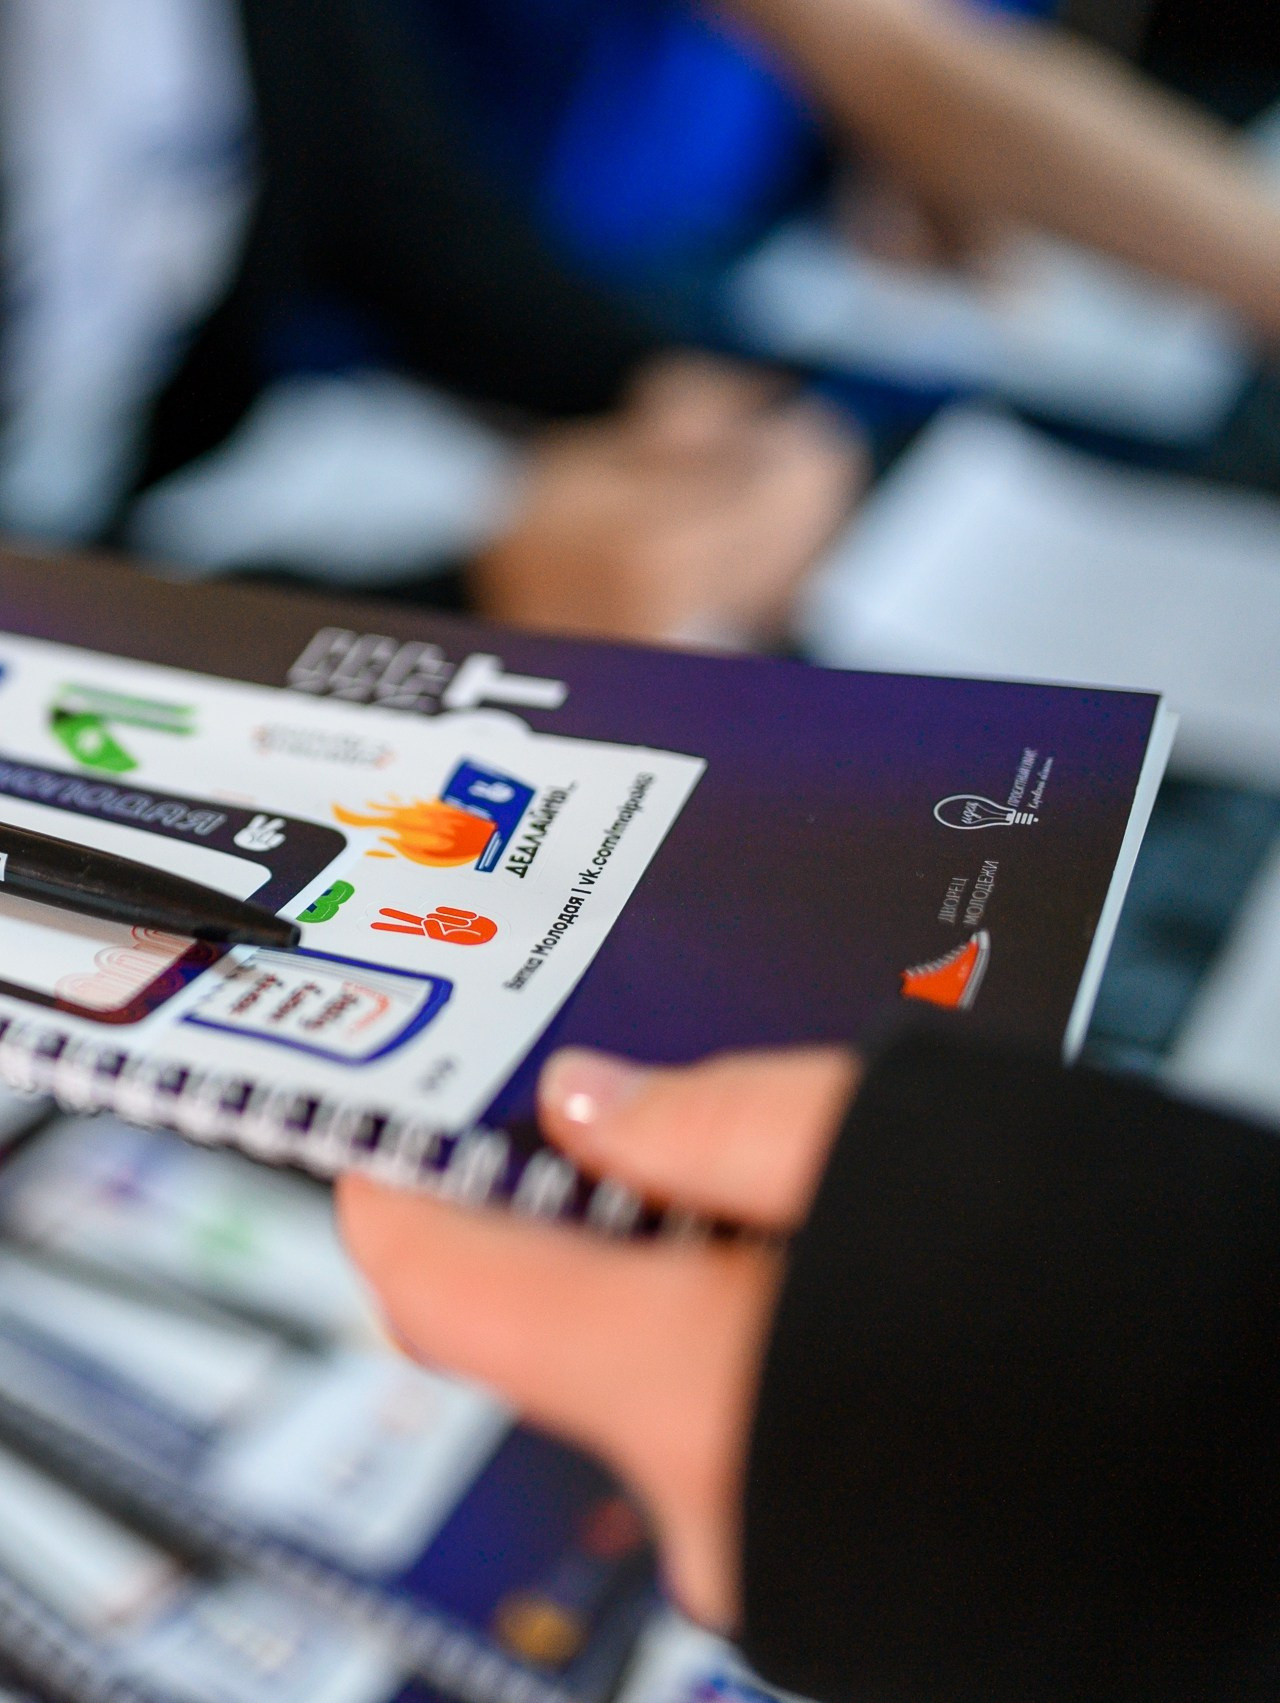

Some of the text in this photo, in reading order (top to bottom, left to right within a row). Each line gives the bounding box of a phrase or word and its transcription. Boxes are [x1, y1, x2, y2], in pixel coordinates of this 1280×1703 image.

[937, 877, 969, 923] ДВОРЕЦ
[963, 860, 999, 925] МОЛОДЕЖИ
[530, 896, 587, 957] Молодая
